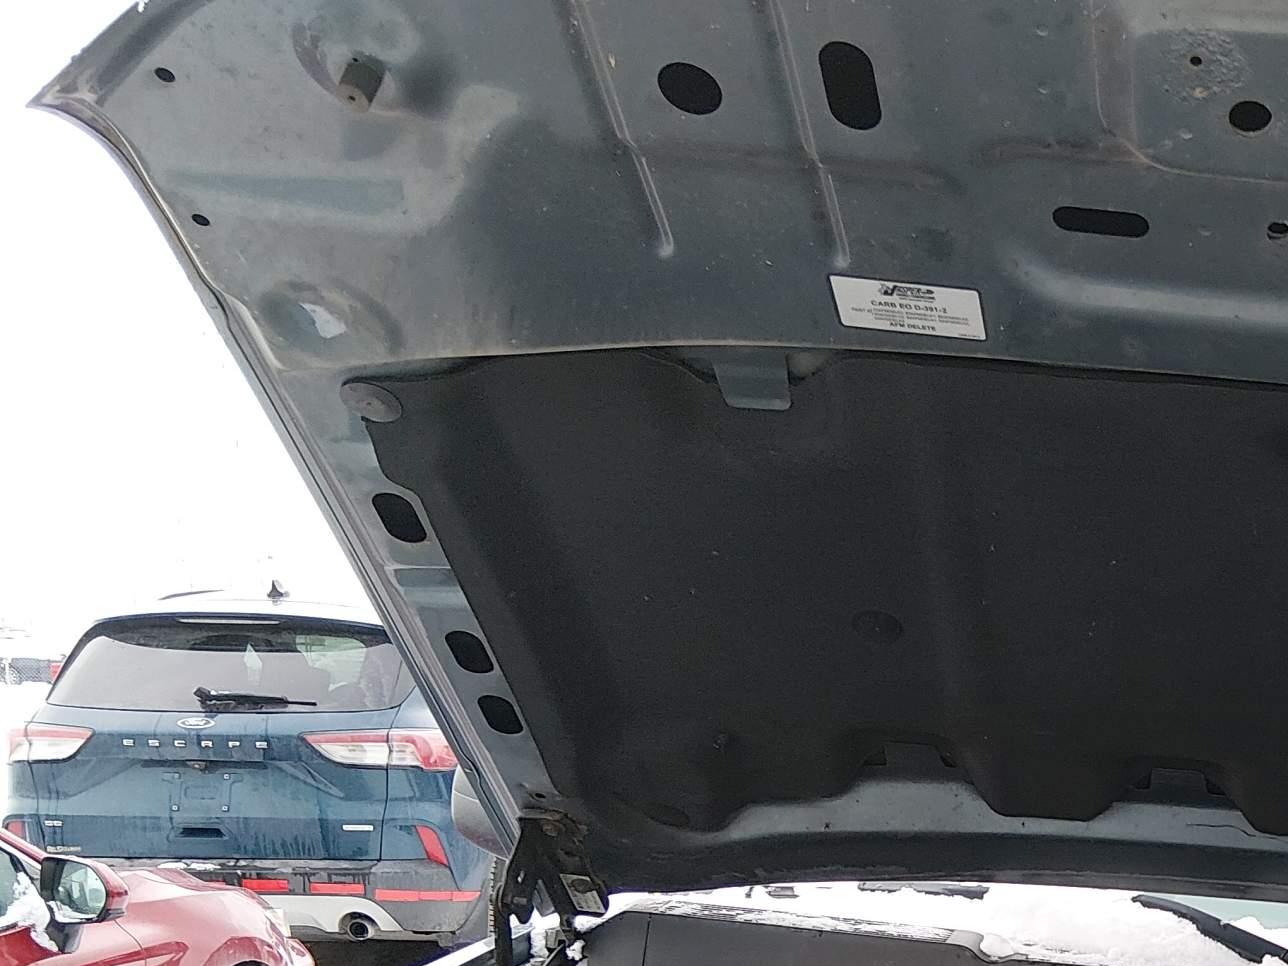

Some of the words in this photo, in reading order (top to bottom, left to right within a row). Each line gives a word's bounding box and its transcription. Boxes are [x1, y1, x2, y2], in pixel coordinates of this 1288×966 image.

[871, 300, 897, 309] CARB
[907, 323, 936, 332] DELETE
[122, 738, 268, 749] ESCAPE
